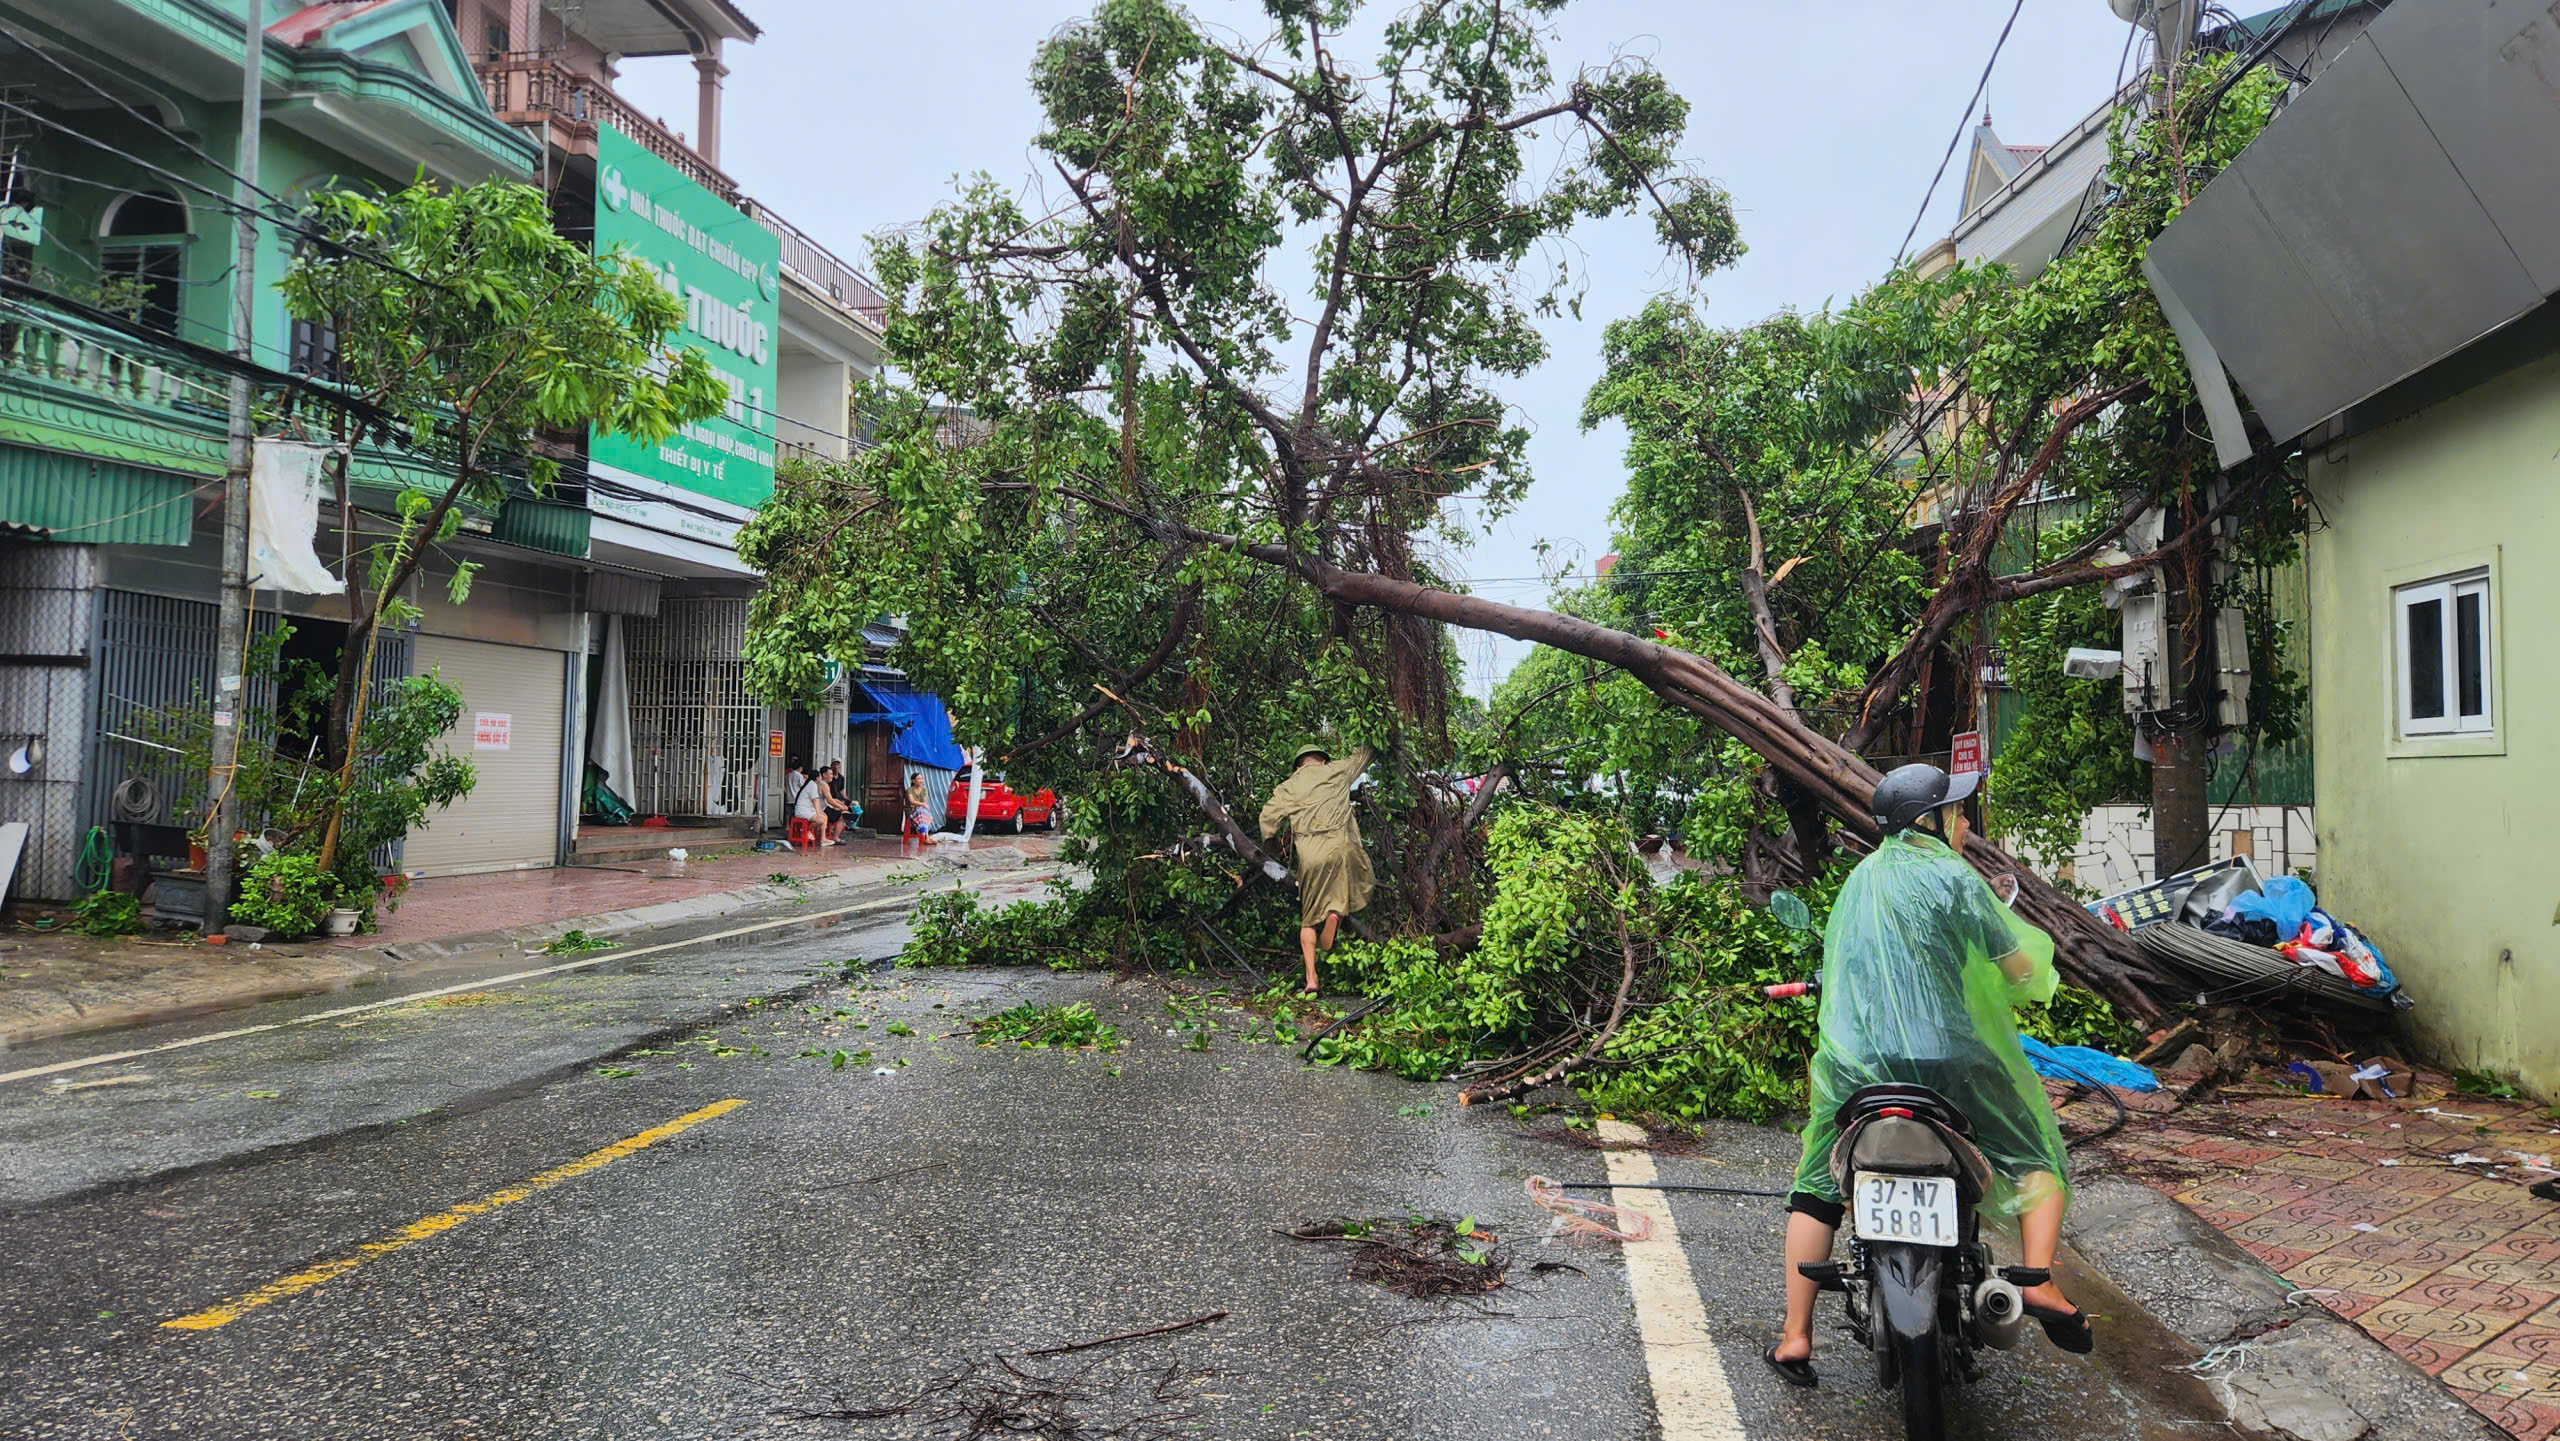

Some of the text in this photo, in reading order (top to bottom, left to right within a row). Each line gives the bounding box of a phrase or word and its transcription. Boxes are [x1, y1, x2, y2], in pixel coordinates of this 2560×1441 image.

[630, 188, 651, 223] NHÀ
[654, 203, 686, 241] THUỐC
[688, 224, 707, 255] ĐẠT
[708, 236, 741, 275] CHUẨN
[741, 256, 759, 284] GPP
[685, 284, 769, 367] THUỐC
[750, 387, 763, 428] 1
[659, 444, 725, 480] THIẾT BỊ Y TẾ
[1871, 1178, 1939, 1208] 37-N7
[1871, 1208, 1940, 1240] 5881
